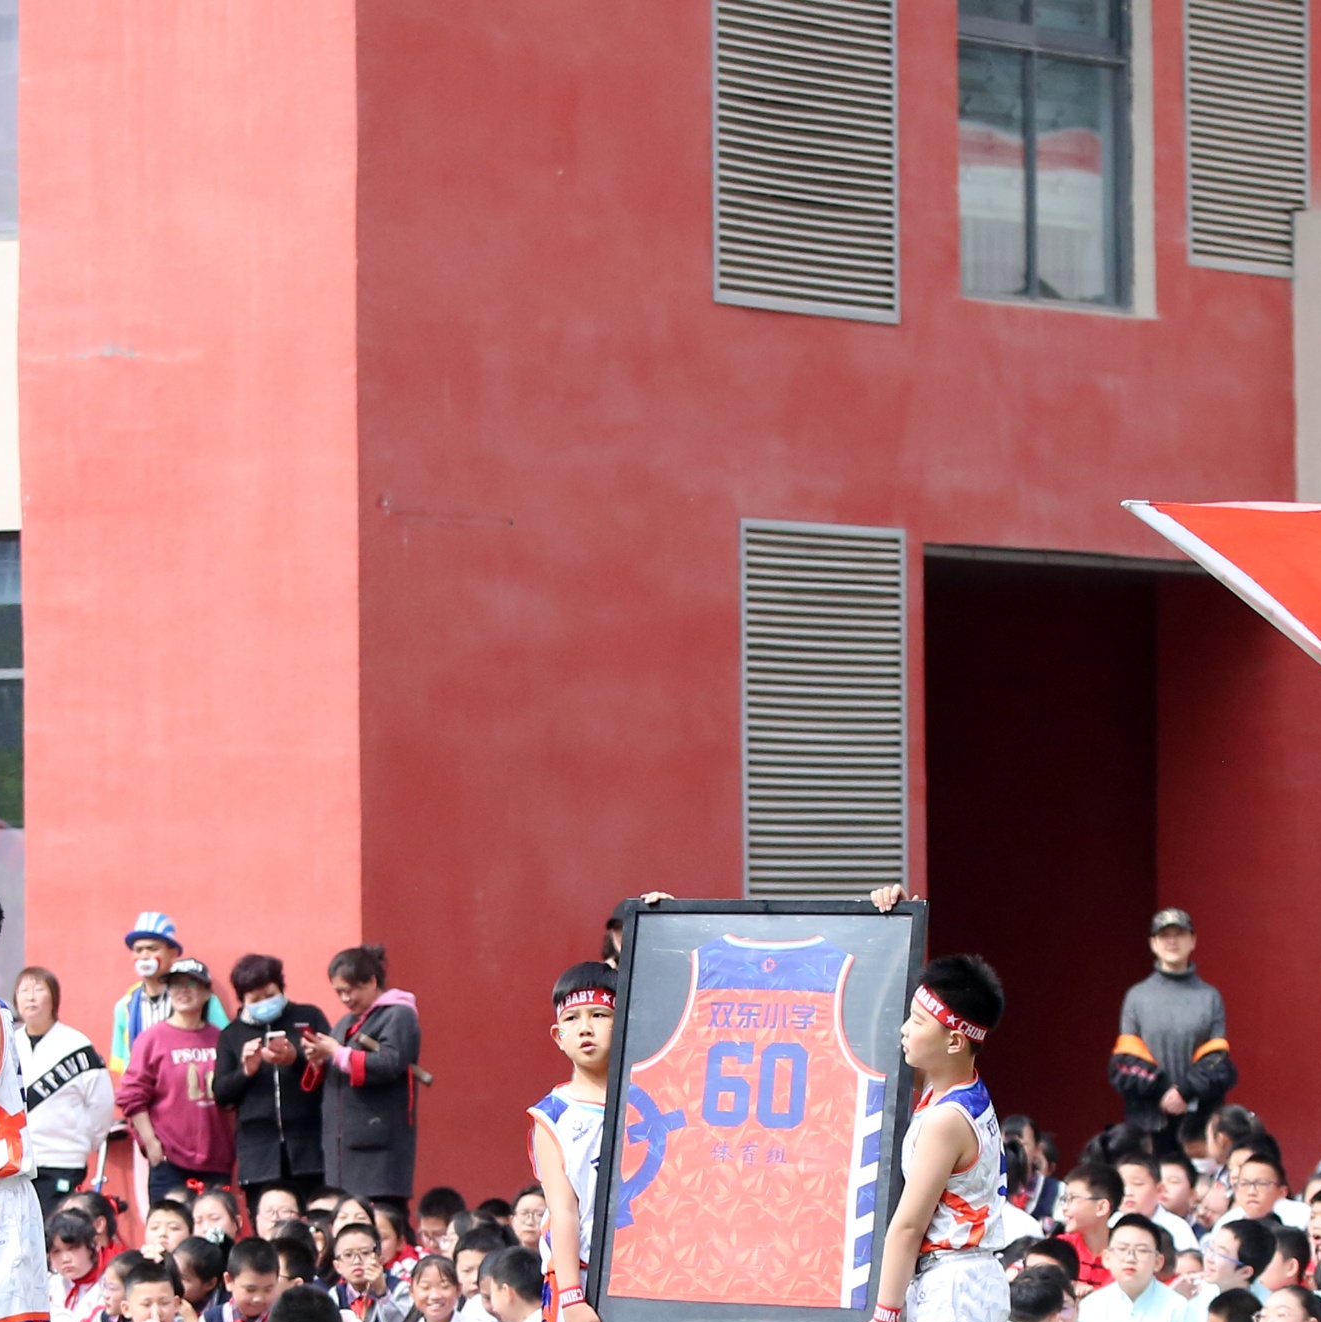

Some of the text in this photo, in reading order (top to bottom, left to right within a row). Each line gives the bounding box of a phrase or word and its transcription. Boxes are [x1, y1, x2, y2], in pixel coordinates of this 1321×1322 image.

[565, 989, 596, 1006] BABY
[707, 1001, 816, 1031] 双东小学
[701, 1040, 809, 1130] 60
[711, 1140, 787, 1167] 体育组
